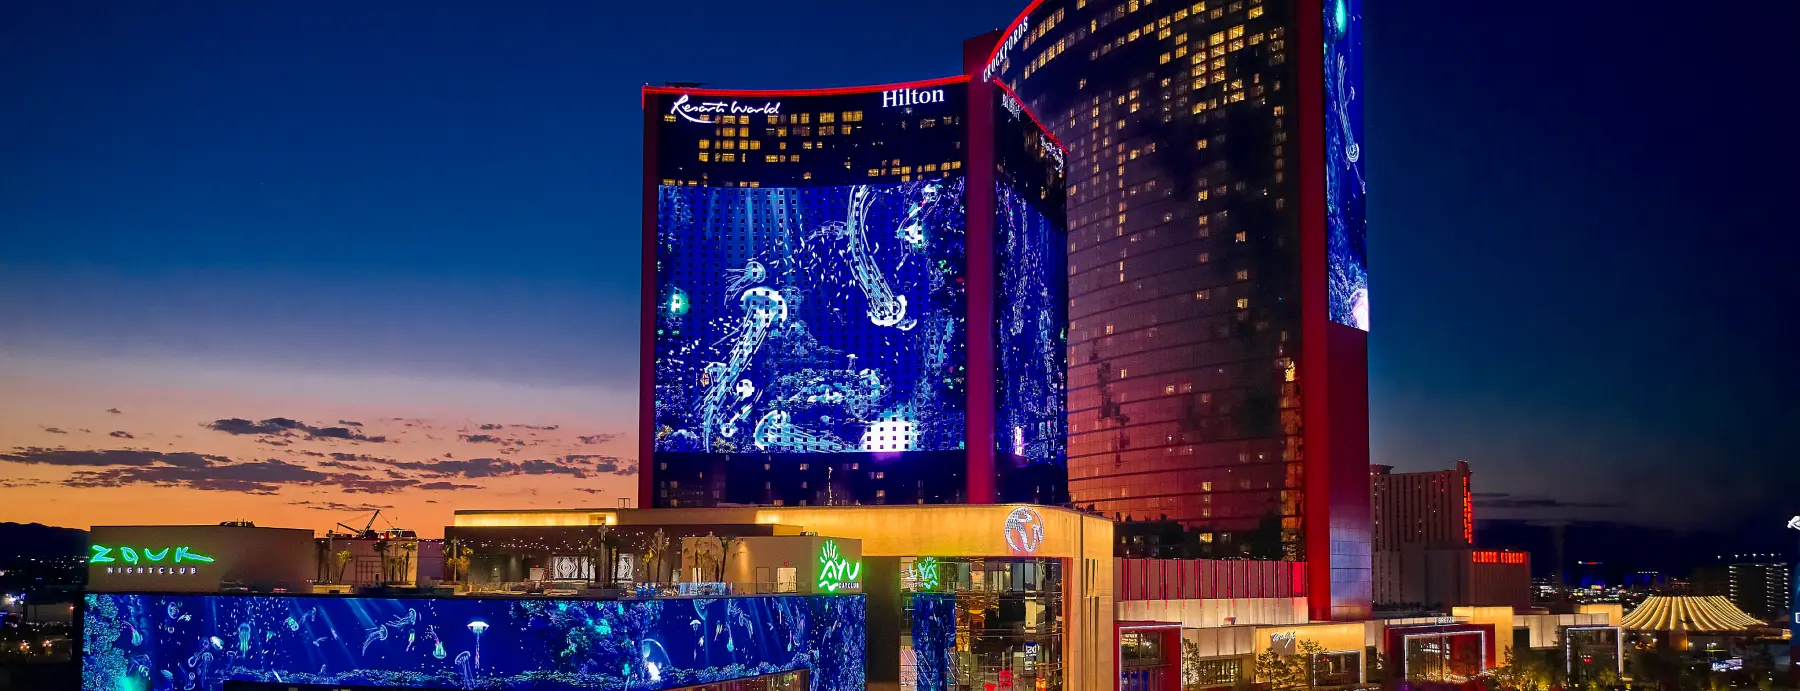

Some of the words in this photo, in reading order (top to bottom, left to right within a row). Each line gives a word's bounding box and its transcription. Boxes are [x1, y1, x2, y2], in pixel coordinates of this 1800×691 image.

[983, 16, 1028, 83] CROCKFORDS
[882, 88, 945, 108] Hilton
[671, 94, 728, 123] Resorts
[730, 100, 781, 114] World
[90, 545, 214, 565] ZOUK
[1472, 551, 1498, 563] CIRCUS
[1500, 552, 1526, 564] CIRCUS
